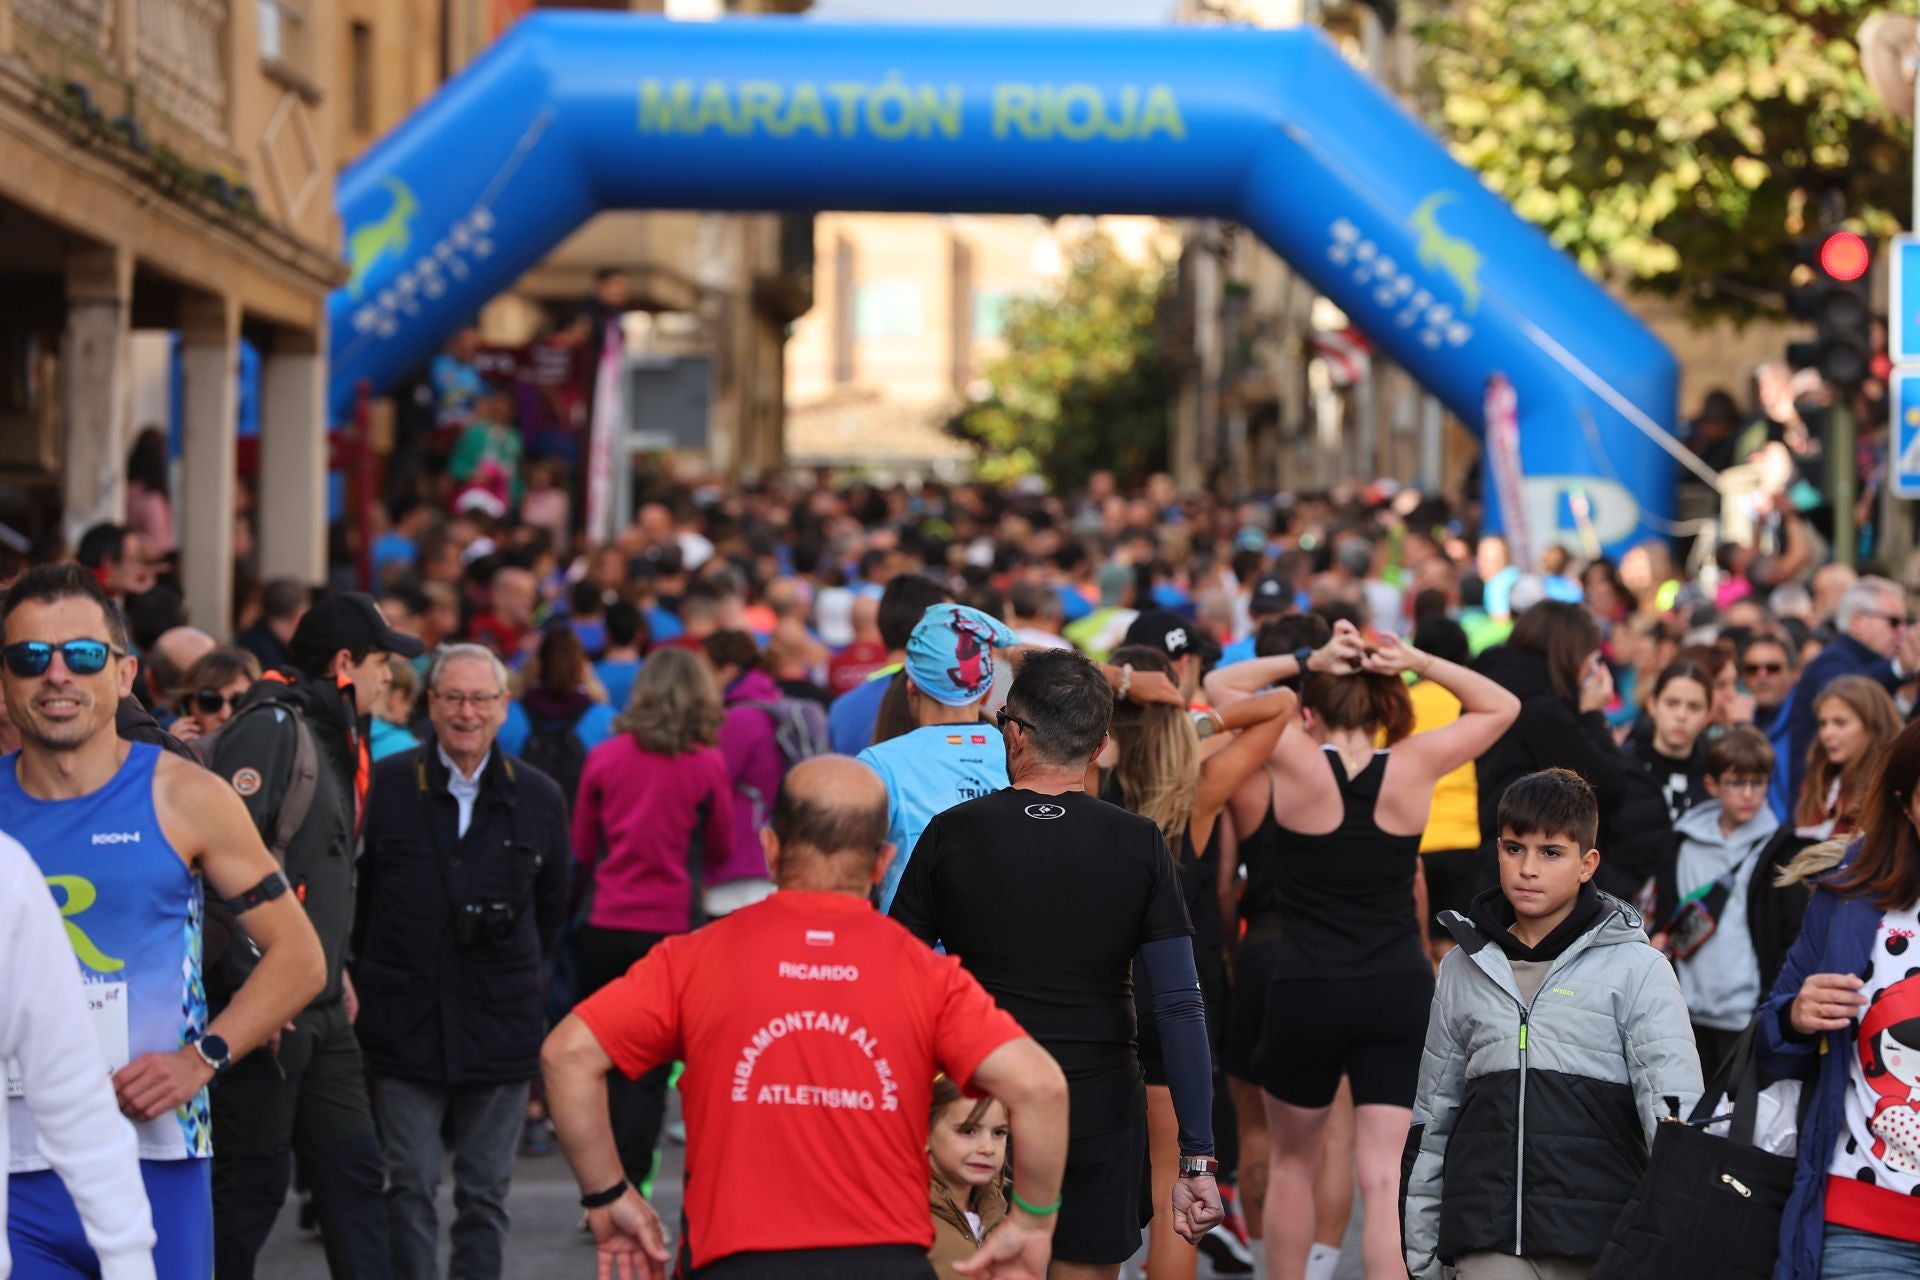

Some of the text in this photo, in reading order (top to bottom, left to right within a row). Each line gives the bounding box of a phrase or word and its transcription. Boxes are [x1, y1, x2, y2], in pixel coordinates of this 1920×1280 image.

[638, 69, 1188, 142] MARATÓN RIOJA
[779, 961, 859, 982] RICARDO
[731, 1010, 898, 1112] RIBAMONTAN AL MAR
[757, 1084, 875, 1111] ATLETISMO
